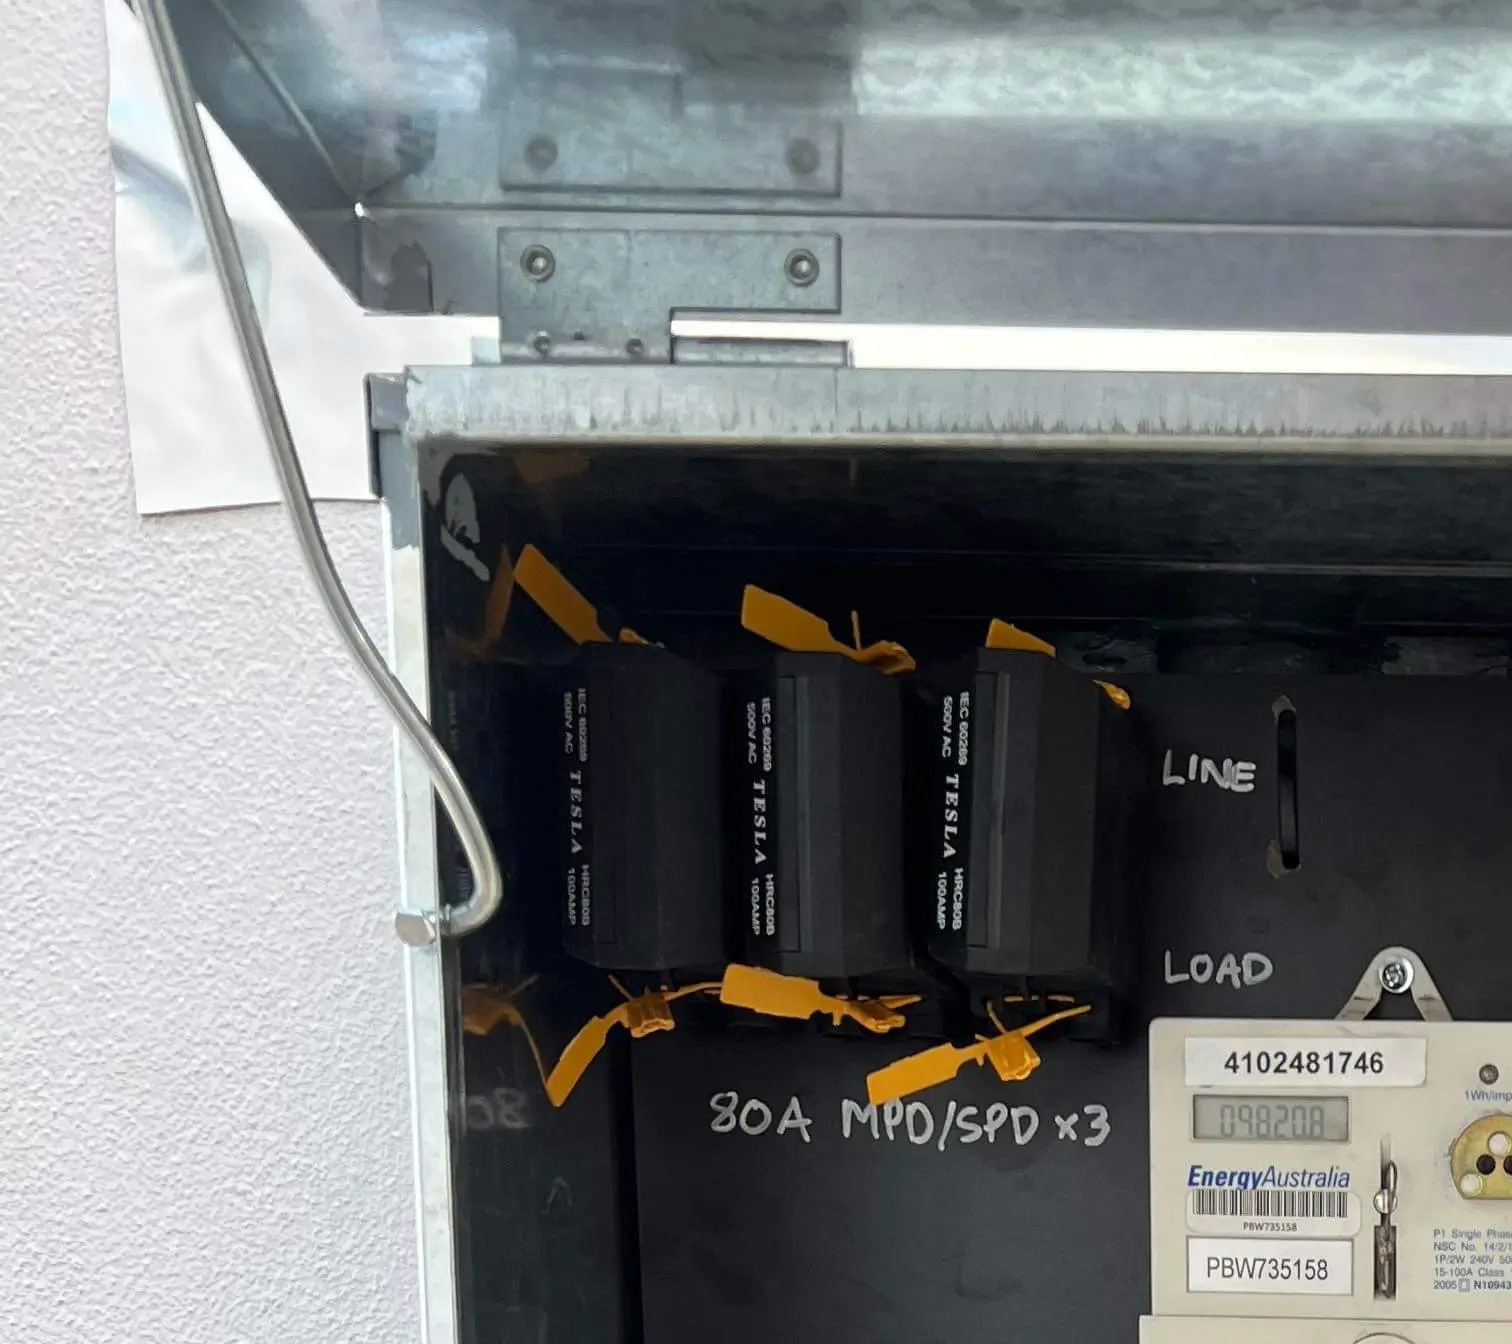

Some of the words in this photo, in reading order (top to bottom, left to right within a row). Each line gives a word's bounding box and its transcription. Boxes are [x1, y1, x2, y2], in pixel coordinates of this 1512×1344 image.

[761, 696, 770, 725] IEC
[942, 696, 953, 734] 500V
[960, 690, 970, 720] IEC
[746, 702, 756, 740] 500V
[748, 742, 756, 764] AC
[942, 736, 952, 758] AC
[1162, 748, 1257, 794] LINE
[570, 770, 584, 854] TESLA
[753, 780, 768, 864] TESLA
[944, 772, 960, 858] TESLA
[750, 878, 760, 936] 100AMP
[936, 870, 948, 930] 100AMP
[1164, 950, 1274, 990] LOAD
[1224, 1050, 1384, 1074] 4102481746
[708, 1090, 812, 1144] 80A
[840, 1098, 1040, 1152] MPD/SPD
[1187, 1164, 1350, 1190] EnergyAustralia
[1243, 1222, 1298, 1232] PBW735158
[1432, 1228, 1446, 1238] P1
[1451, 1228, 1482, 1241] Single
[1432, 1241, 1456, 1252] NSC
[1470, 1254, 1496, 1264] 240V
[1206, 1256, 1328, 1280] PBW735158
[1478, 1268, 1504, 1278] Class
